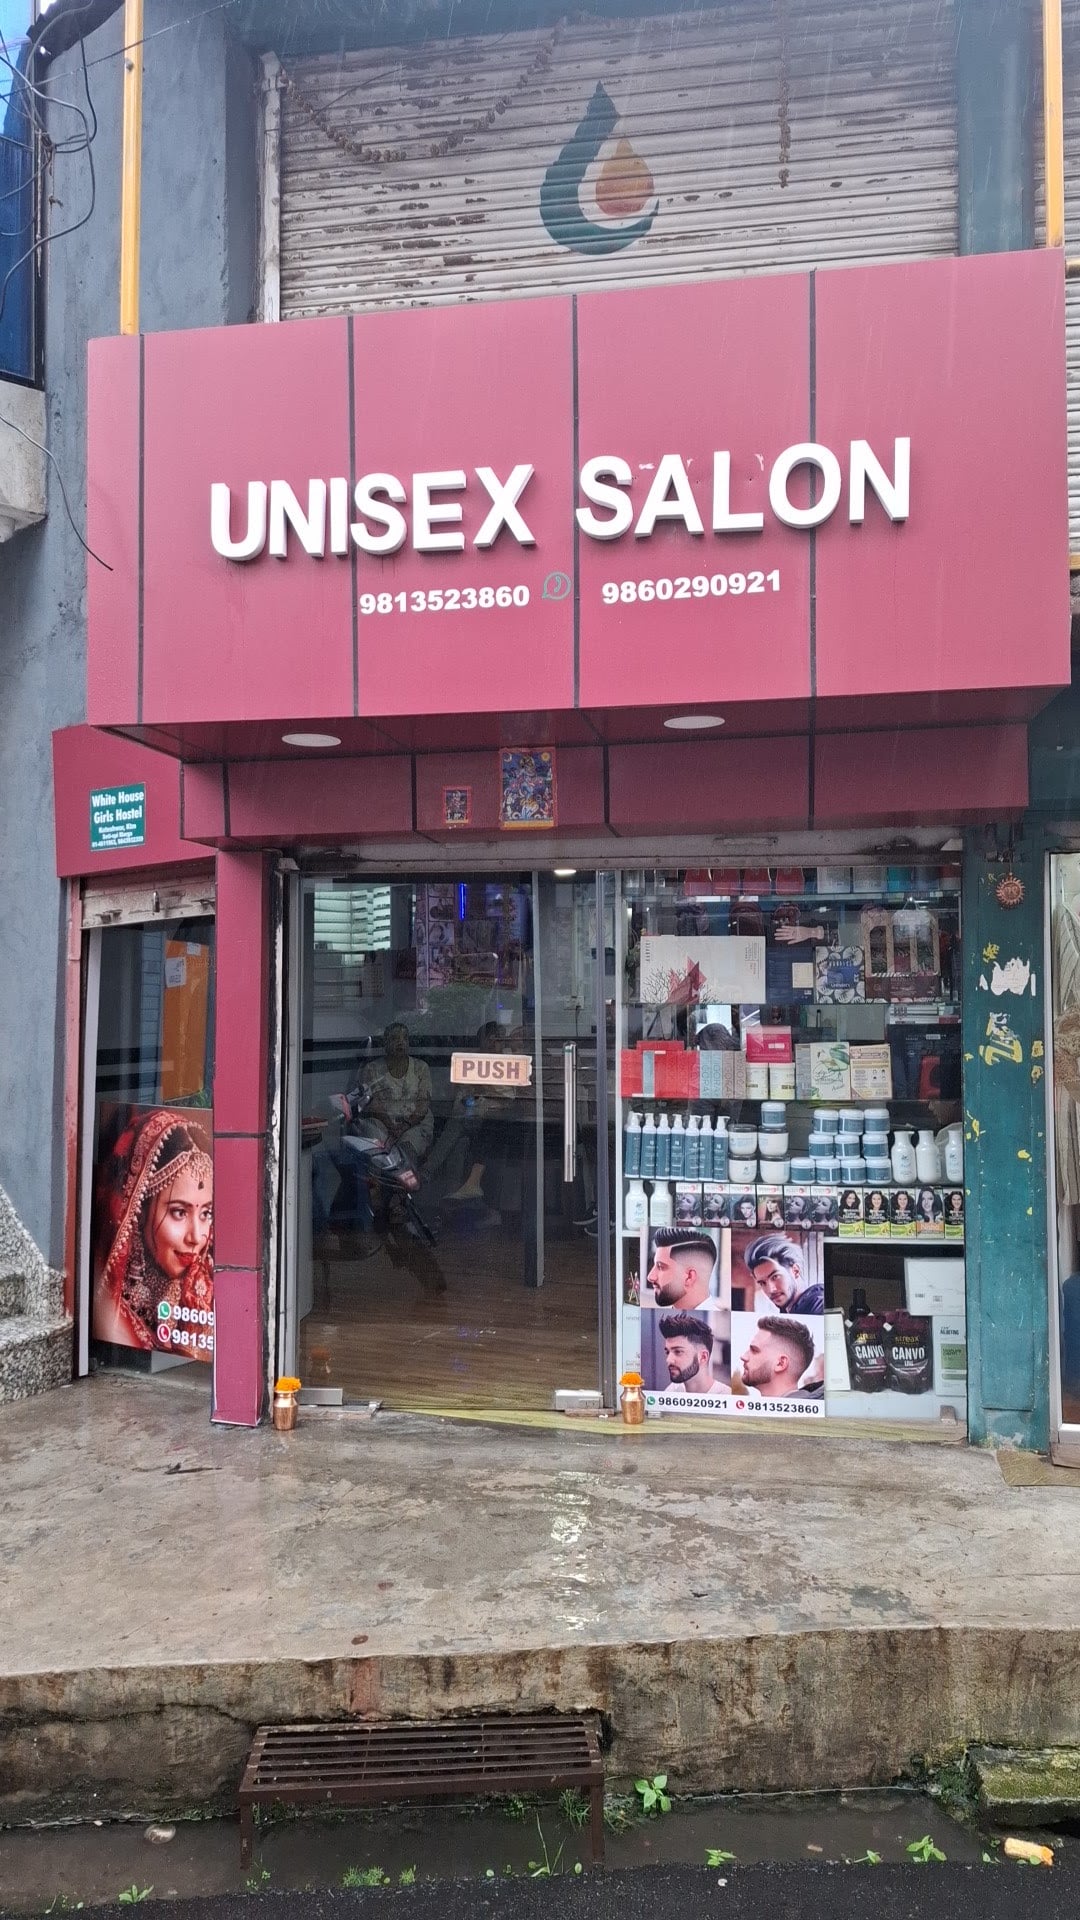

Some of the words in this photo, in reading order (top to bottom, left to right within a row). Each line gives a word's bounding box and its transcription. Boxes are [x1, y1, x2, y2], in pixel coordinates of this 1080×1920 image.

[210, 464, 537, 561] UNISEX
[575, 437, 911, 540] SALON
[359, 585, 530, 614] 9813523860
[601, 569, 781, 604] 9860290921
[91, 793, 117, 807] White
[118, 791, 145, 804] House
[93, 810, 114, 824] Girls
[115, 805, 143, 821] Hostel
[462, 1060, 520, 1079] PUSH
[855, 1345, 885, 1359] CANVO
[892, 1347, 925, 1360] CANVO
[658, 1397, 728, 1409] 9860920921
[747, 1402, 819, 1414] 9813523860
